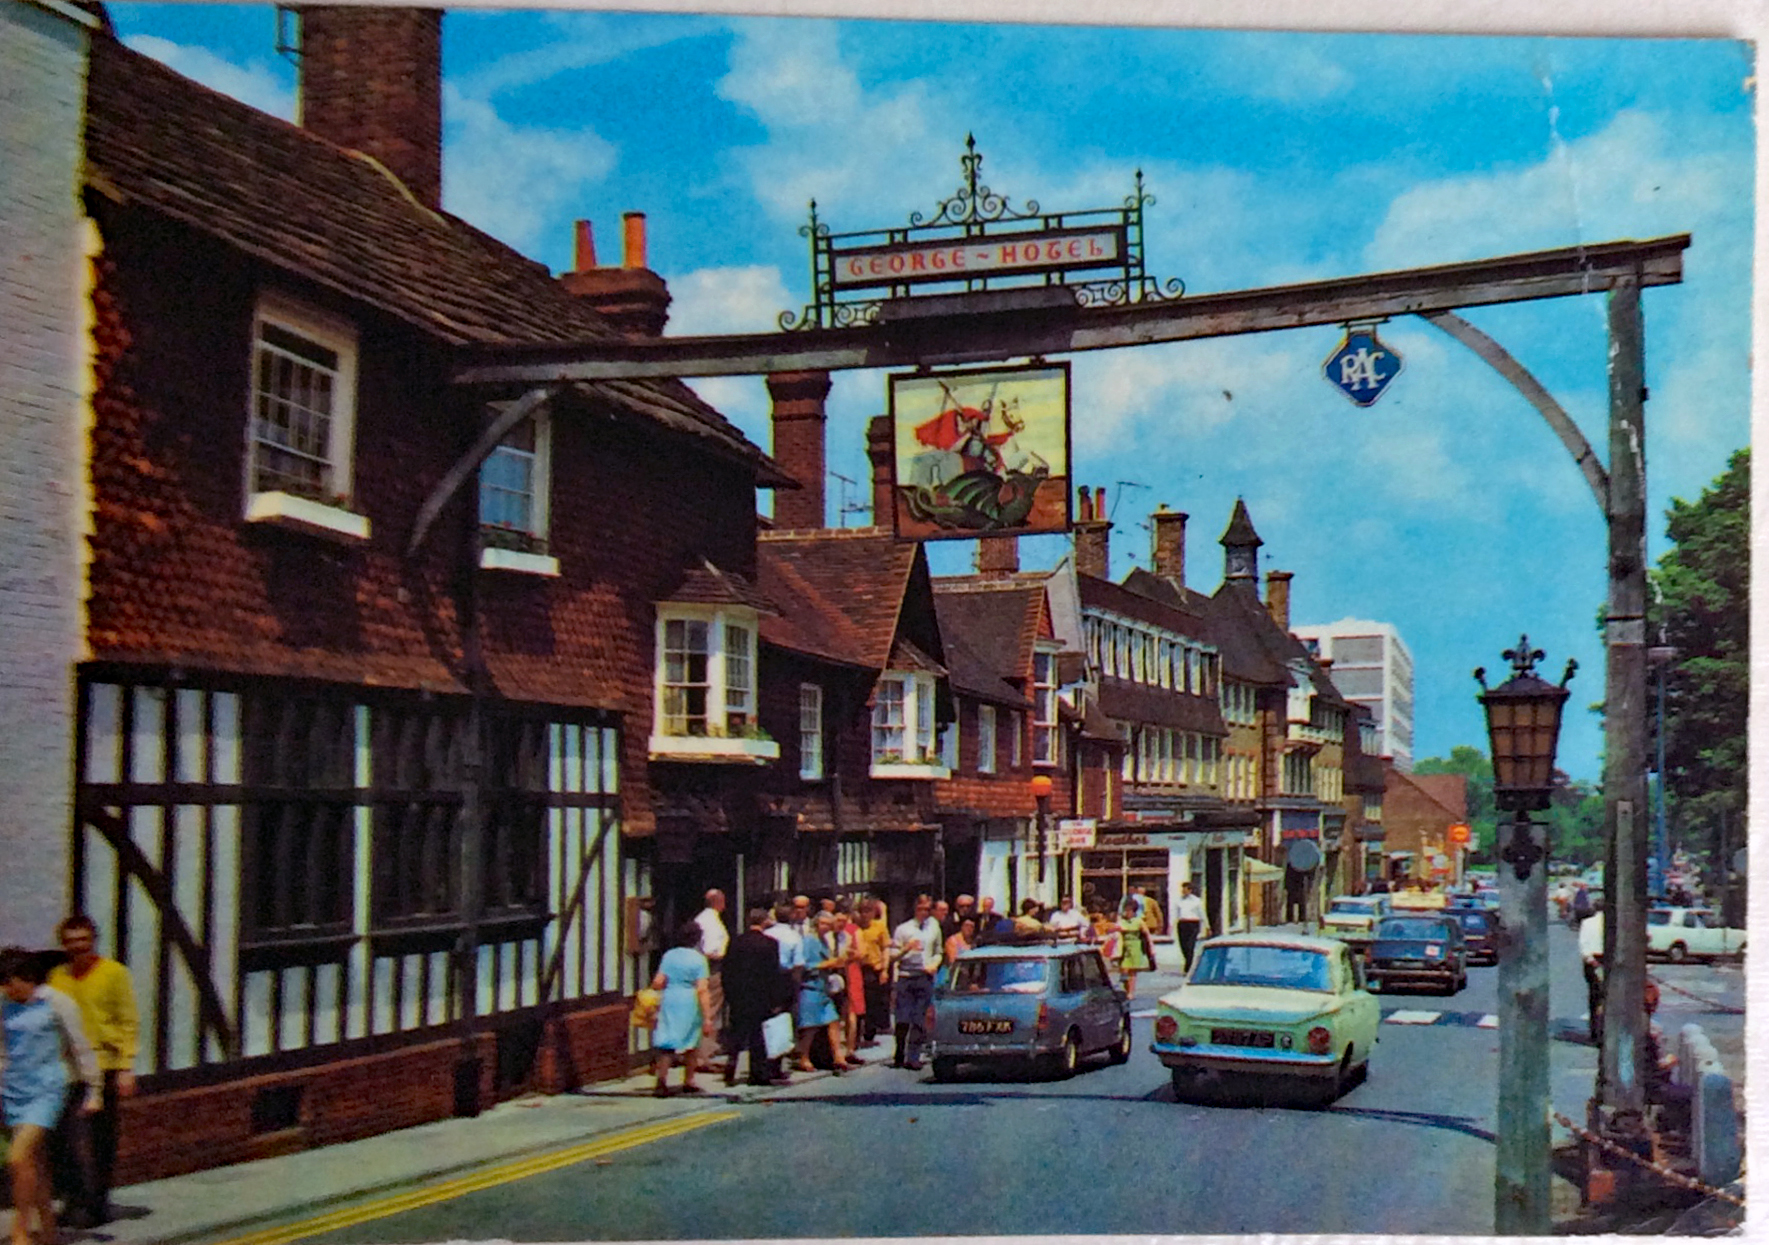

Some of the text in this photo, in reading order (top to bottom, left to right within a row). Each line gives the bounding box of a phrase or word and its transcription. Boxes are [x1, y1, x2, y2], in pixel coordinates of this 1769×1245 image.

[849, 247, 966, 277] GEORGE
[1001, 239, 1103, 264] HOTEL
[1340, 348, 1386, 390] RAC
